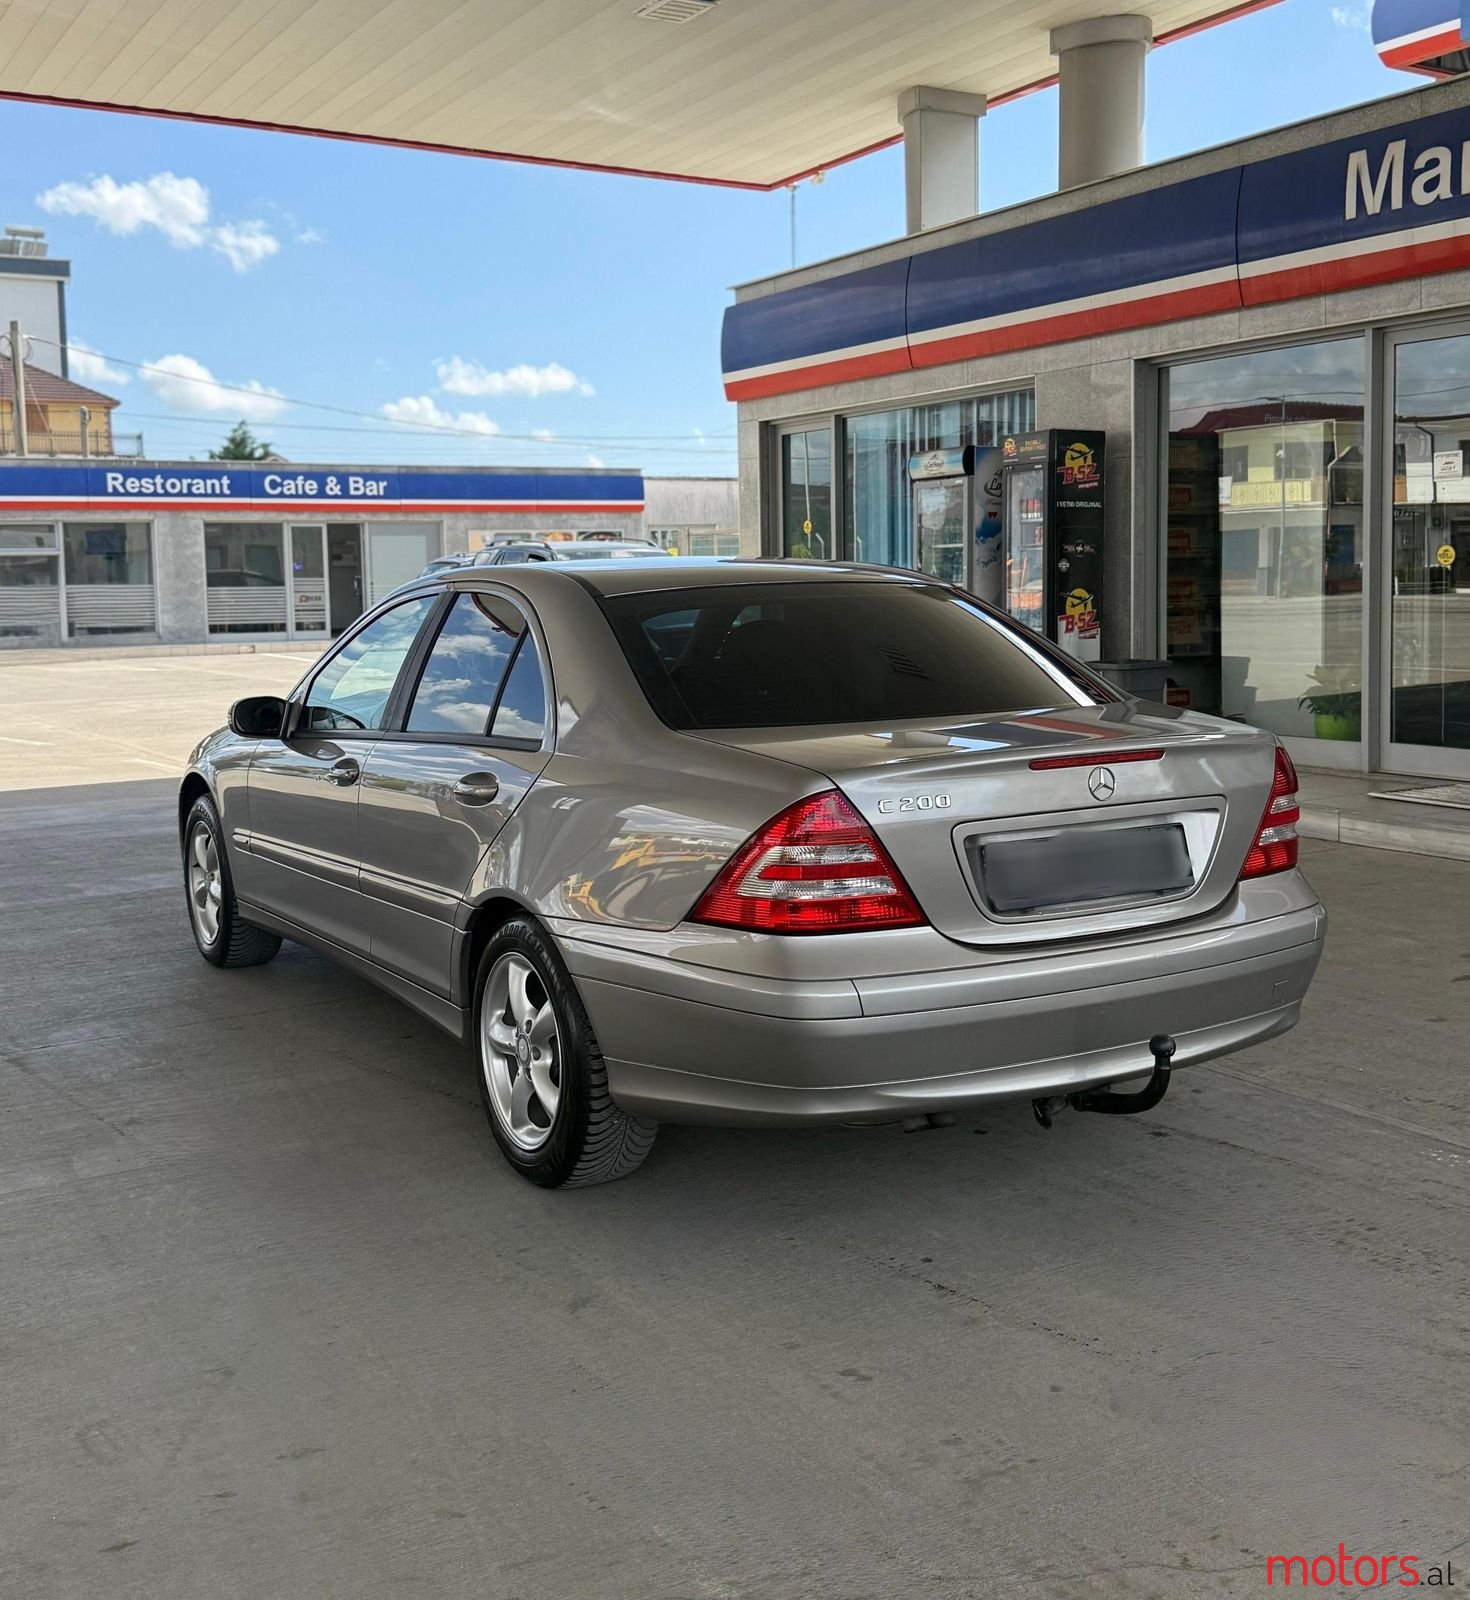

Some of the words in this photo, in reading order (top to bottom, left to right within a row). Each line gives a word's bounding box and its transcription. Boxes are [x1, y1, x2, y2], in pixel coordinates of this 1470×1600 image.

[106, 473, 231, 495] Restorant
[264, 475, 318, 496] Cafe
[325, 477, 342, 496] &
[349, 477, 388, 496] Bar
[878, 799, 894, 814] C
[899, 794, 952, 812] 200
